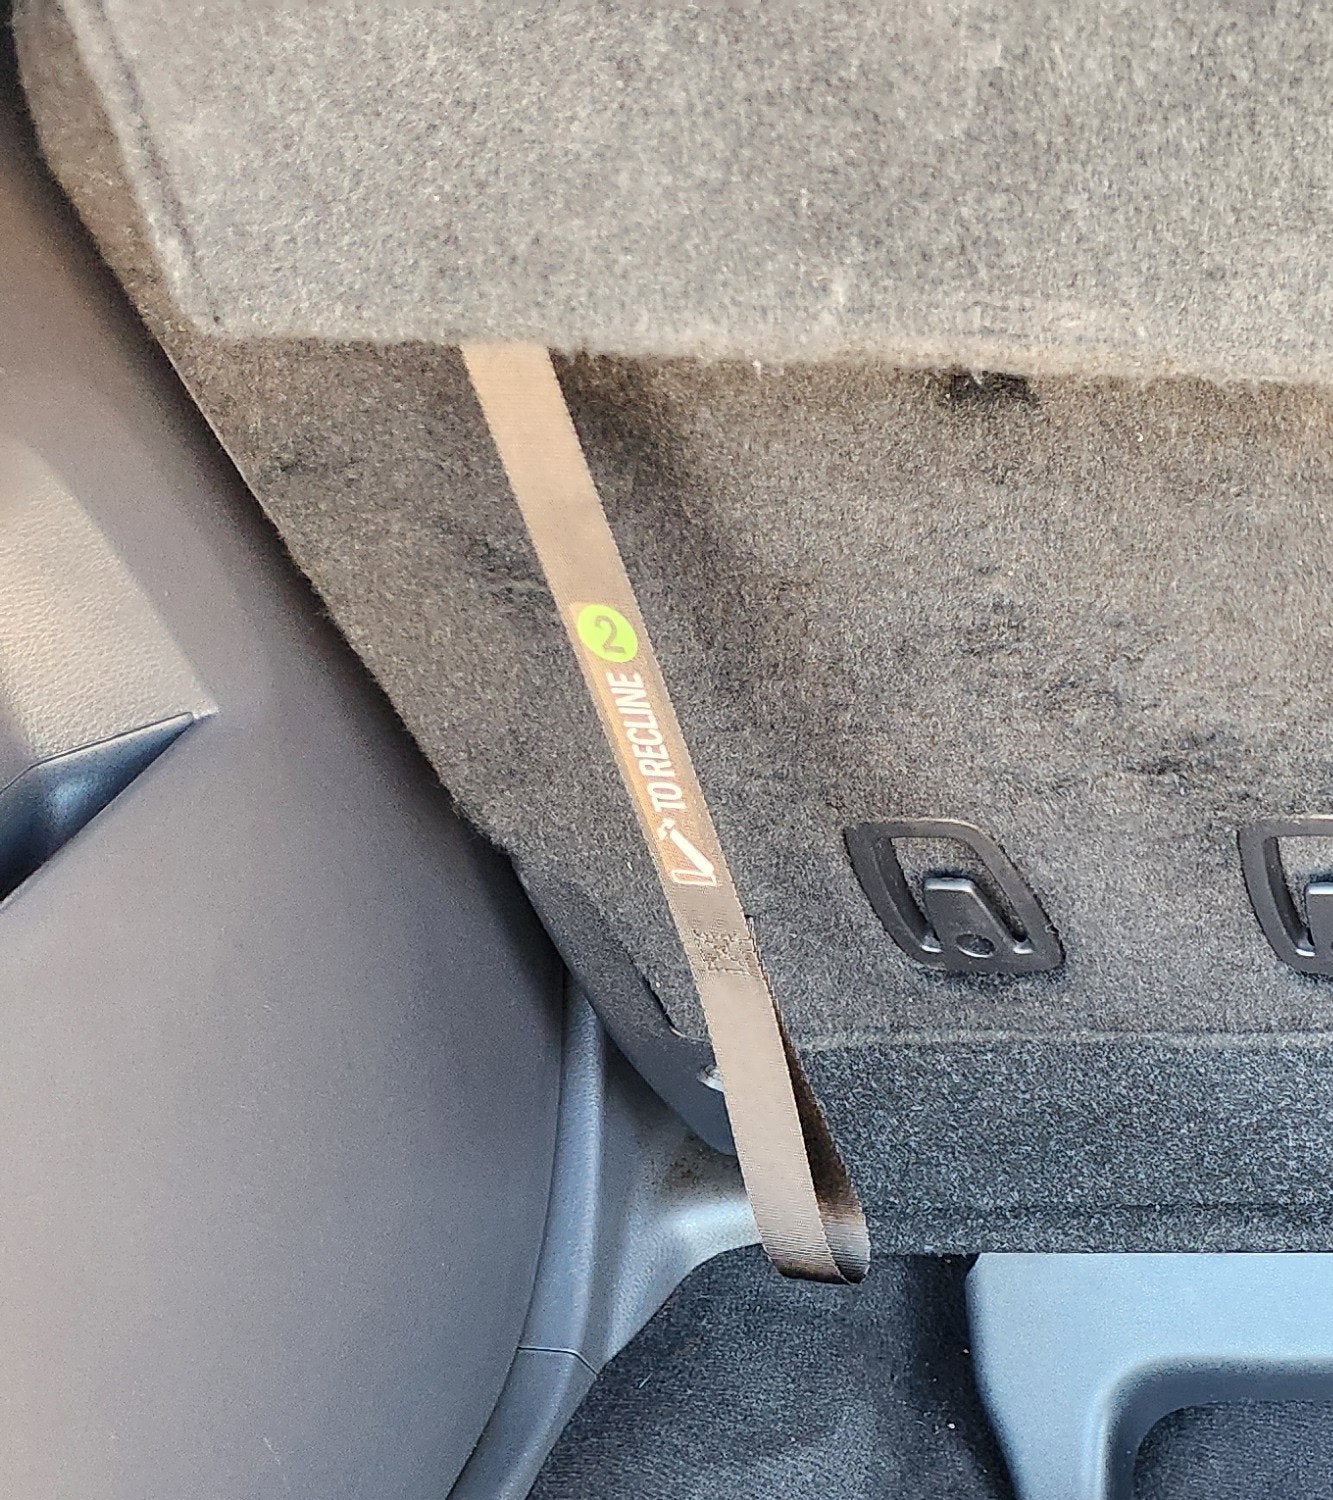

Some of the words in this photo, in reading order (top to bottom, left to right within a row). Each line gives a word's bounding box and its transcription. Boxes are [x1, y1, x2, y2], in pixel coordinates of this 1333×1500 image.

[594, 614, 626, 654] 2
[605, 671, 676, 779] RECLINE
[647, 781, 687, 814] TO
